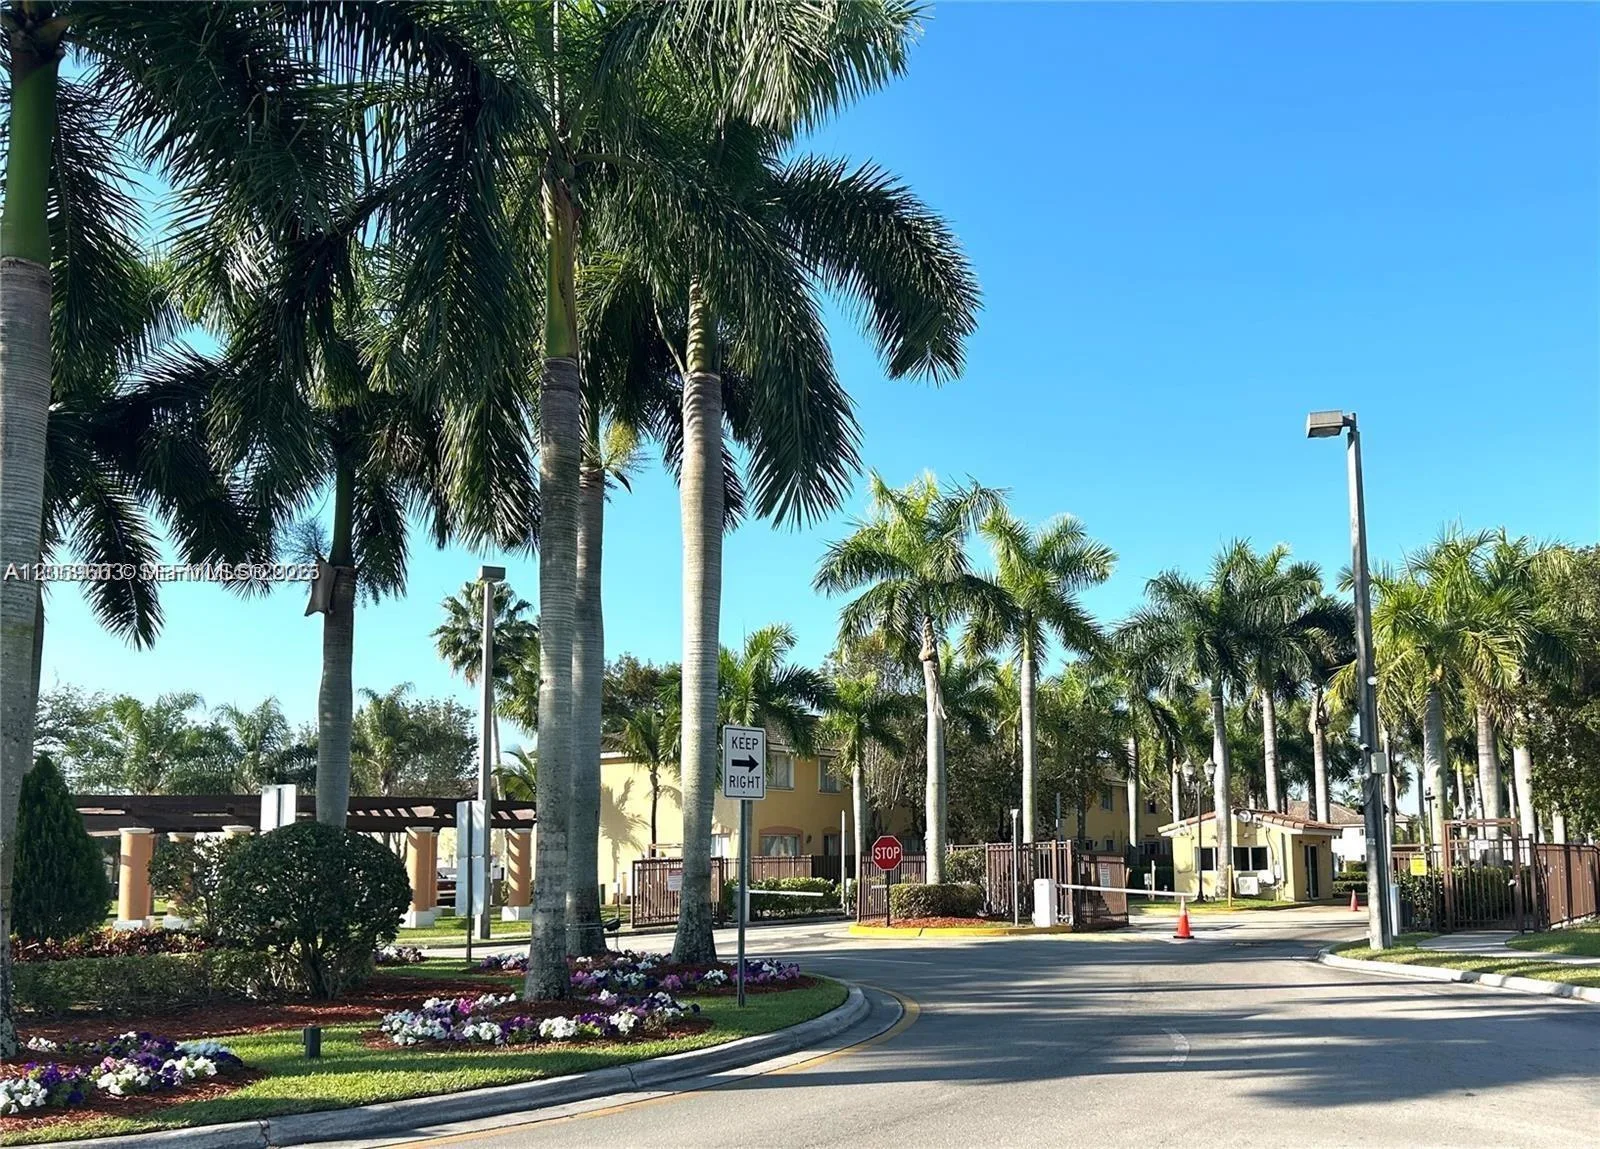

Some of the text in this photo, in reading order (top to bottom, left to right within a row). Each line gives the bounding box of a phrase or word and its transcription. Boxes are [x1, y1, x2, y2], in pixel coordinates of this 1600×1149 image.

[731, 736, 759, 750] KEEP
[729, 775, 761, 789] RIGHT
[874, 846, 901, 860] STOP
